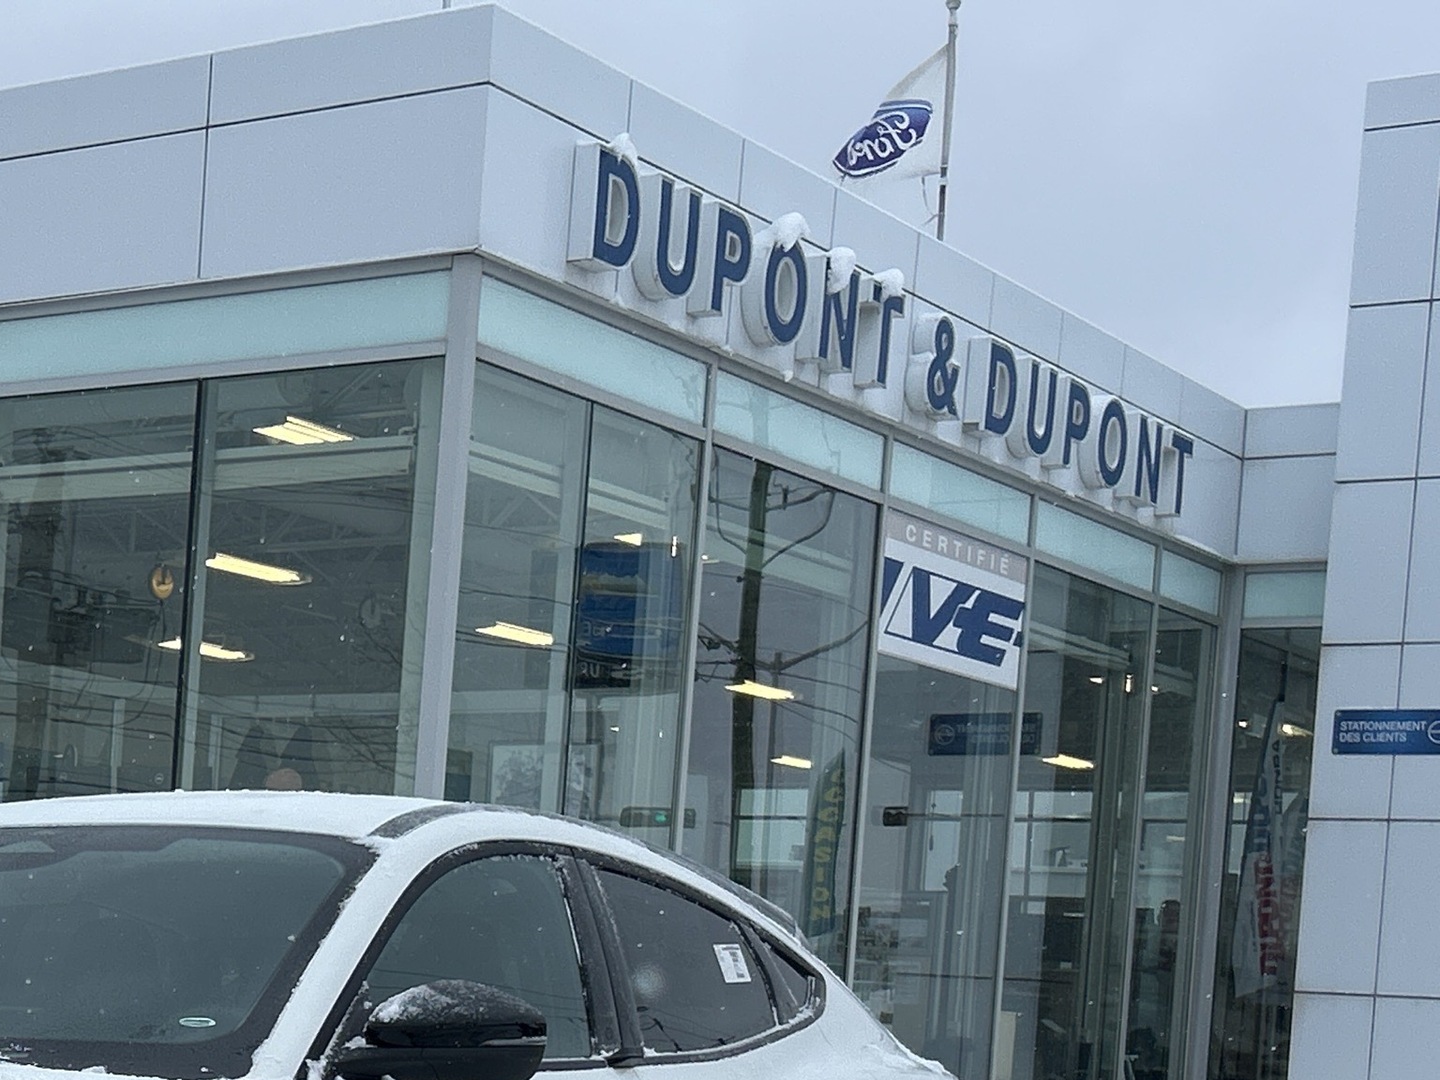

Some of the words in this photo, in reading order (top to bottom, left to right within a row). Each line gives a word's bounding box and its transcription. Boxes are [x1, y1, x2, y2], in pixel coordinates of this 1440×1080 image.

[592, 147, 905, 385] DUPONT
[927, 318, 960, 416] &
[984, 338, 1194, 515] DUPONT
[905, 524, 1011, 575] CERTIFIÉ
[1339, 731, 1360, 743] DES
[1362, 731, 1407, 743] CLIENTS
[1340, 720, 1427, 732] STATIONNEMENT
